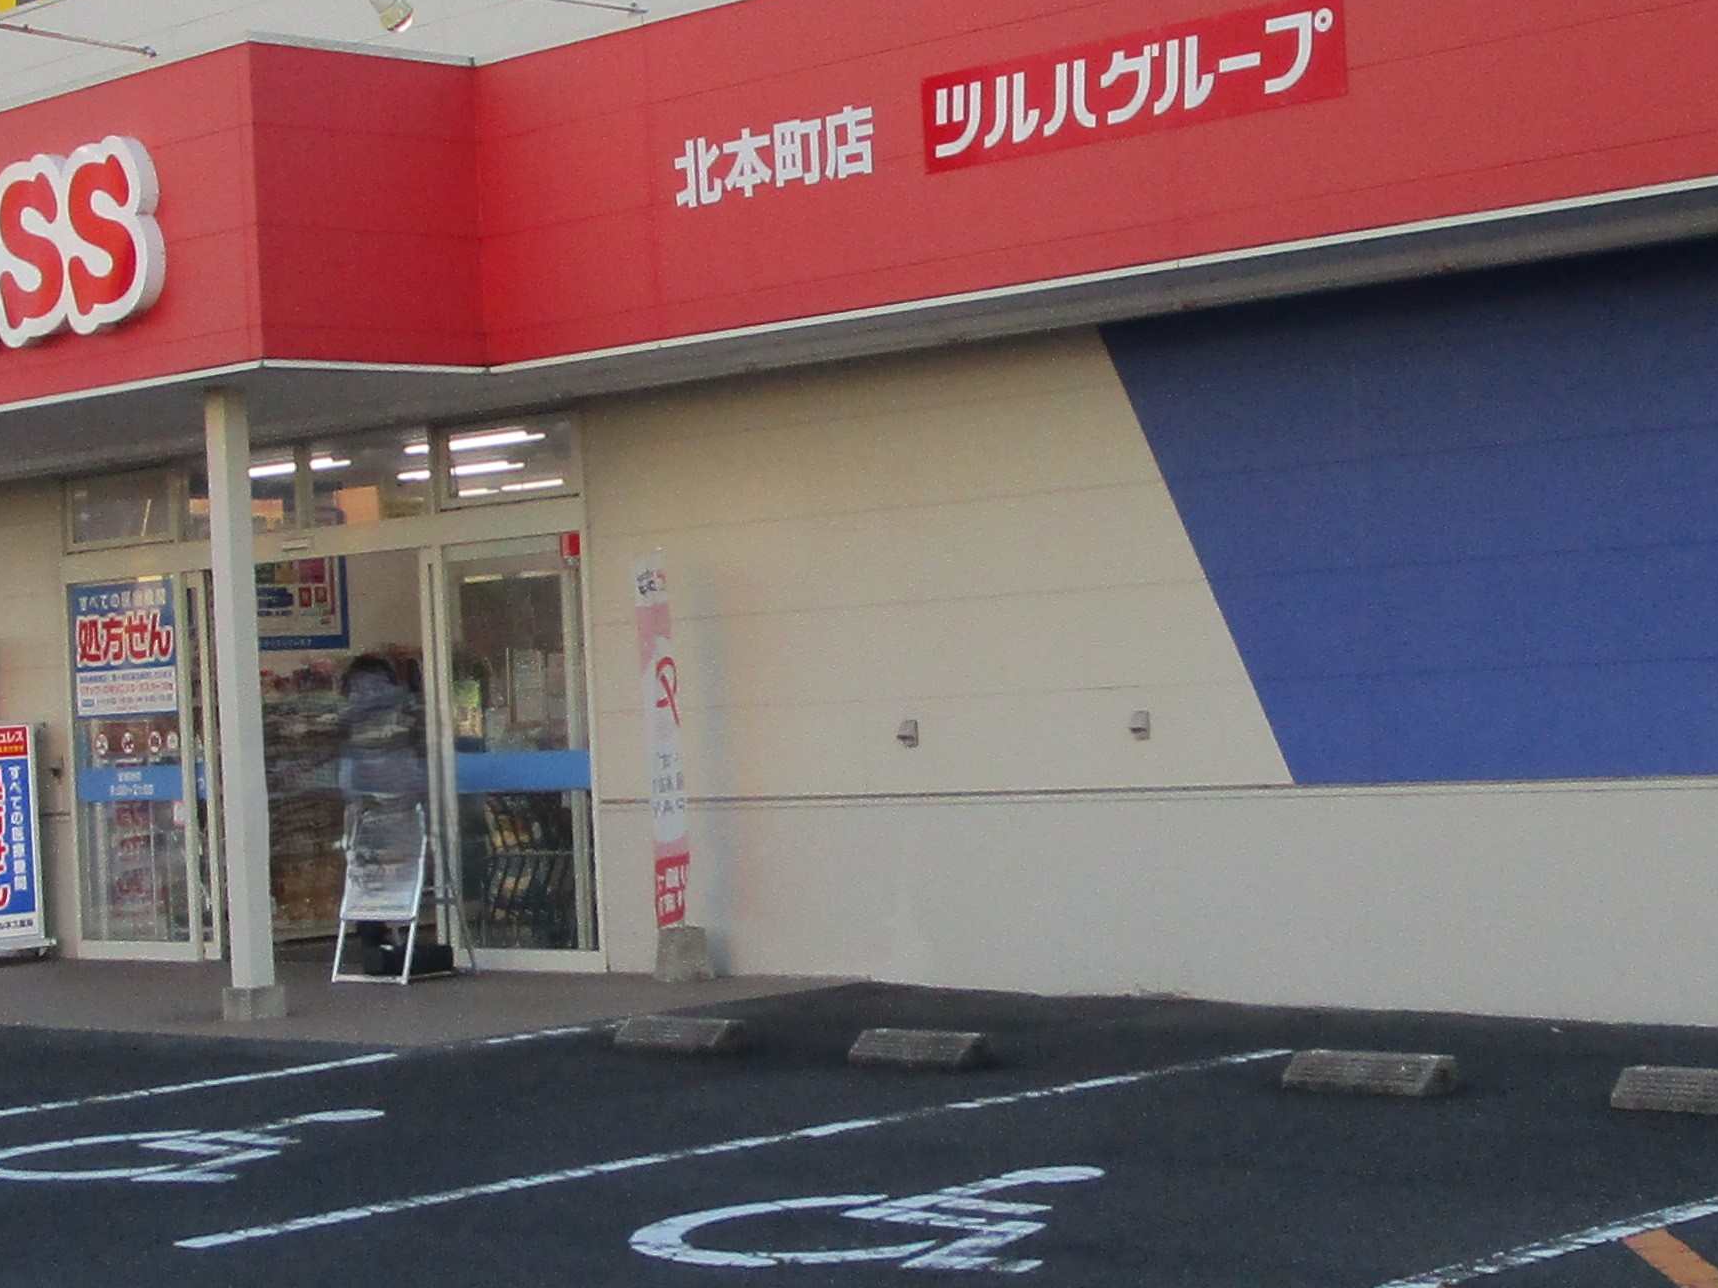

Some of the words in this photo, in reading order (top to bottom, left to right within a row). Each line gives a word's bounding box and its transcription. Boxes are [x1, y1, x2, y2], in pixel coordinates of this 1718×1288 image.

[933, 6, 1336, 159] ツルハグループ
[674, 106, 874, 210] 北本町店
[78, 612, 172, 665] 処方せん
